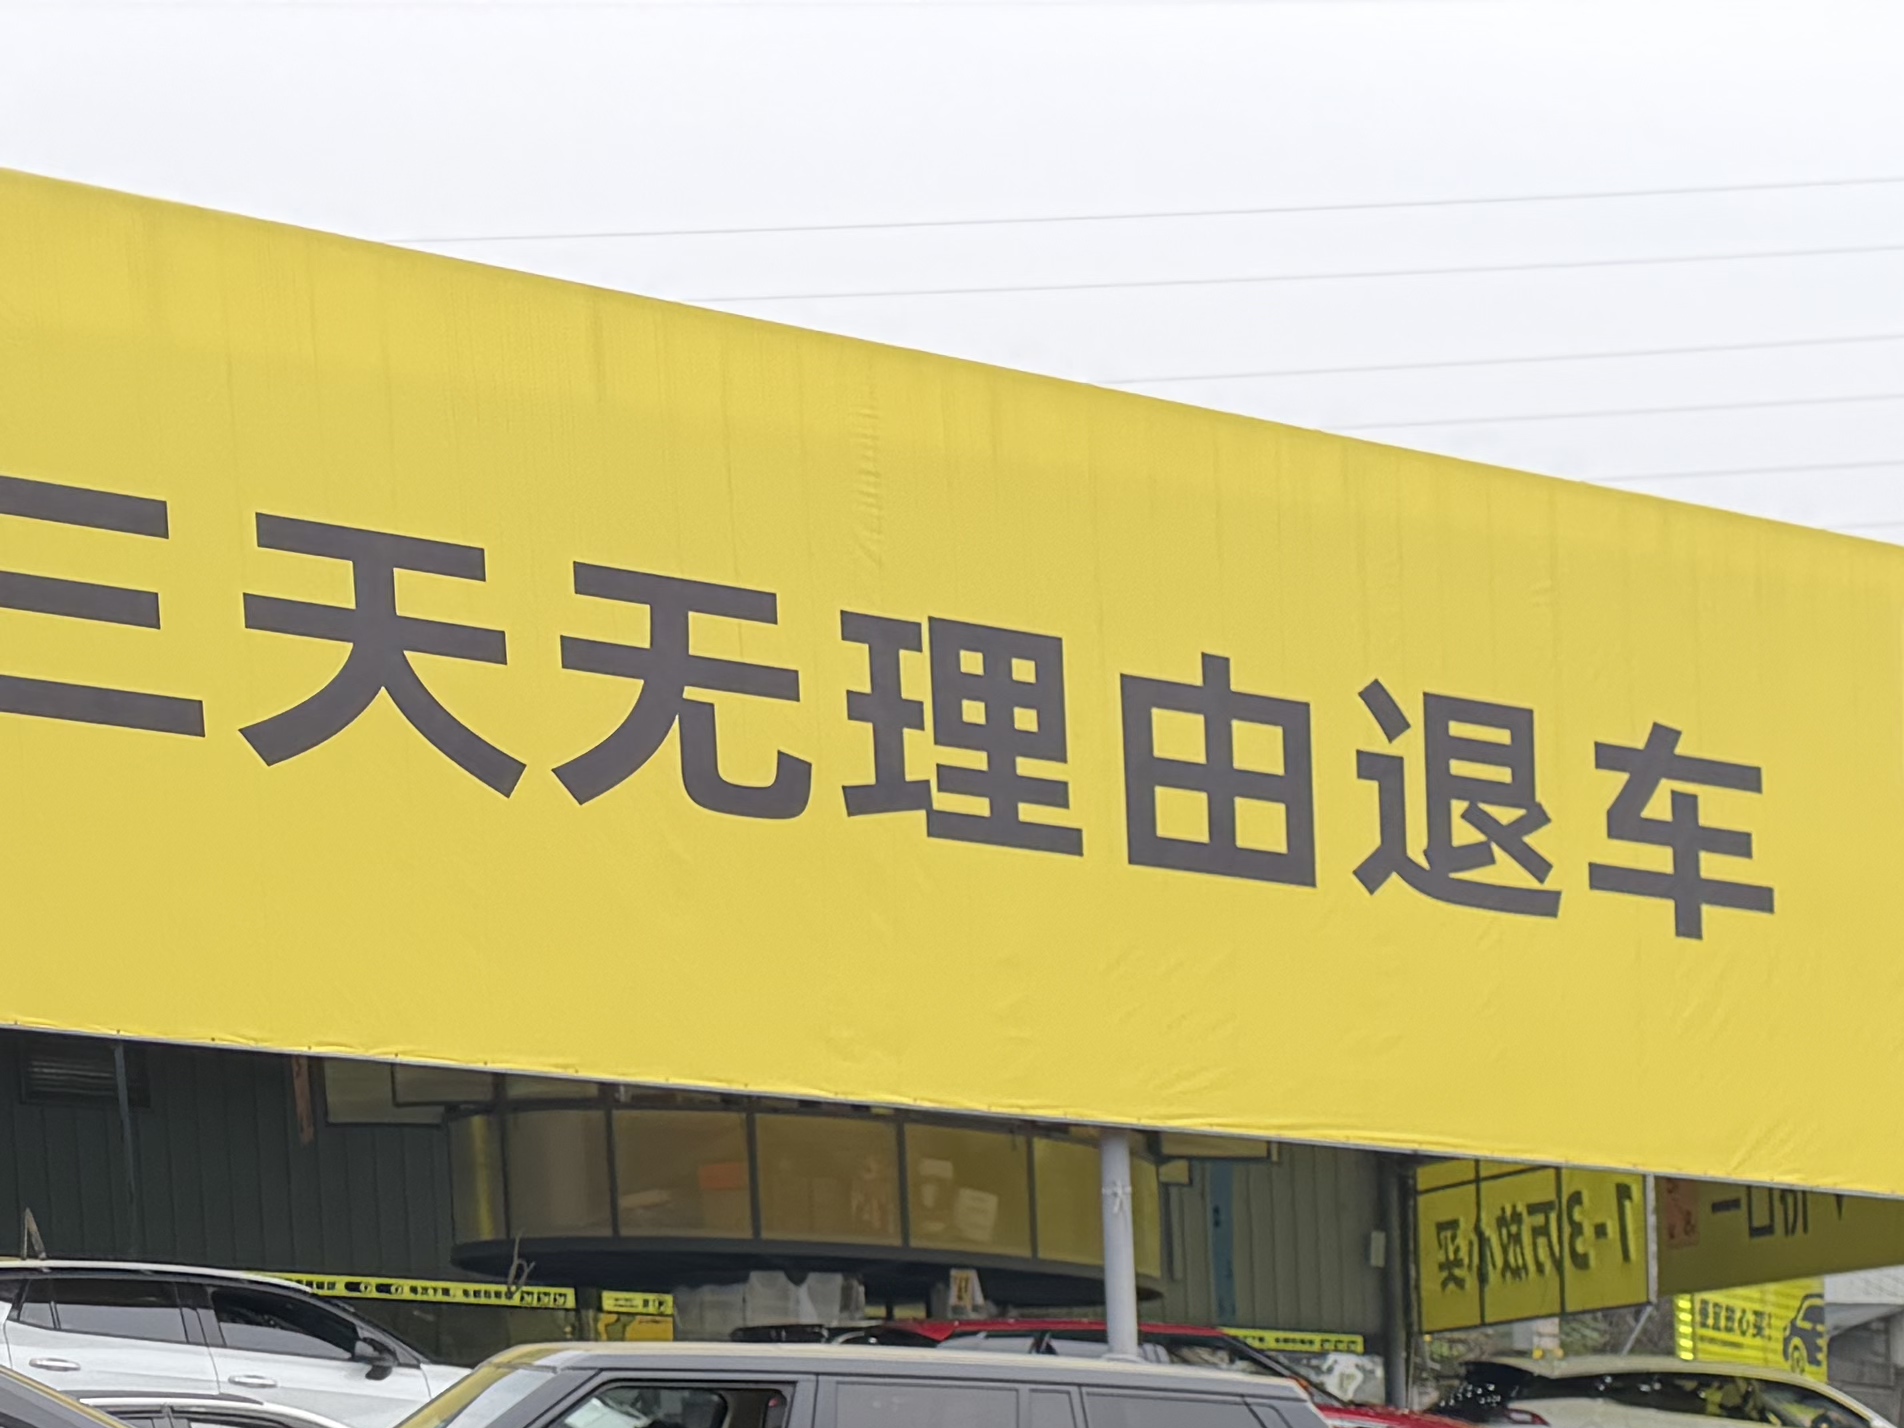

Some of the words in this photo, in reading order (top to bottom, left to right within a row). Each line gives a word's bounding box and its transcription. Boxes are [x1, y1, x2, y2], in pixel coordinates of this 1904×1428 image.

[0, 474, 1775, 941] 三天无理由退车
